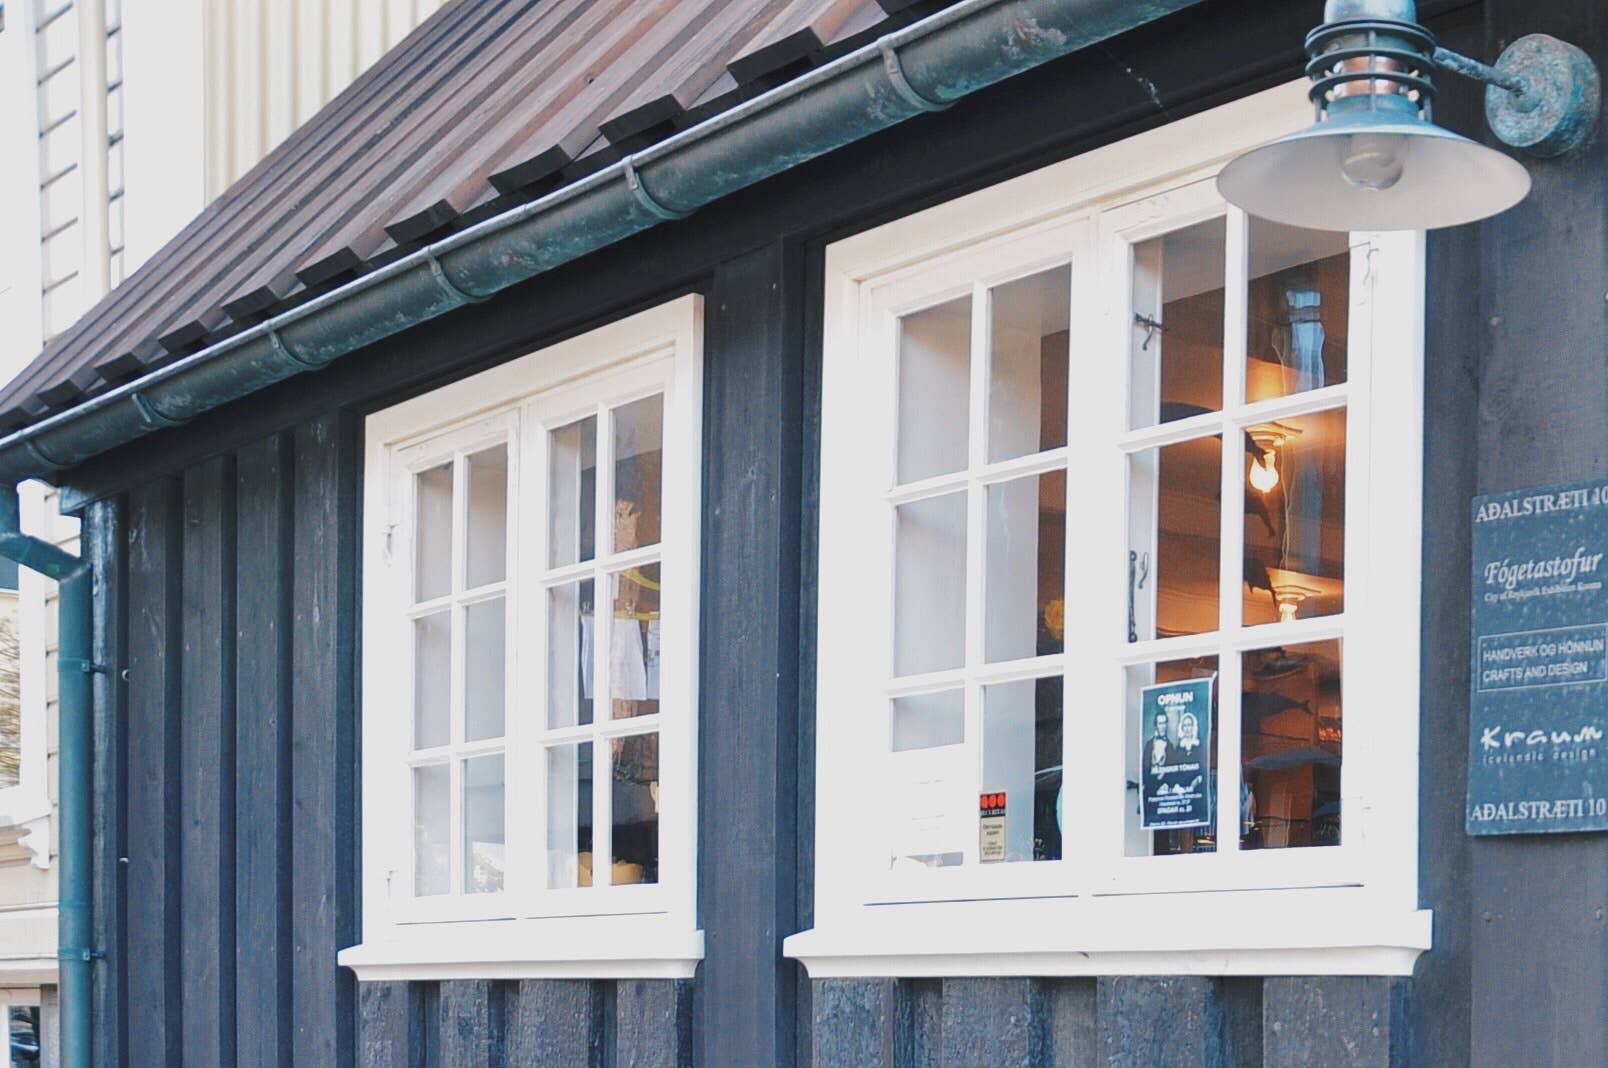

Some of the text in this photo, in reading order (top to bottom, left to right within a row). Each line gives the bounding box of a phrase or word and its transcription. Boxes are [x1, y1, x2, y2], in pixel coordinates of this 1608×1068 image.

[1475, 488, 1589, 523] AÐALSTRÆTI
[1483, 546, 1604, 590] Fógetastofur
[1482, 645, 1538, 661] HANDVERK
[1539, 643, 1556, 657] OG
[1482, 660, 1588, 682] CRAFTS AND DESIGN
[1480, 725, 1603, 751] Kraum
[1470, 798, 1607, 821] AÐALSTRÆTI 10
